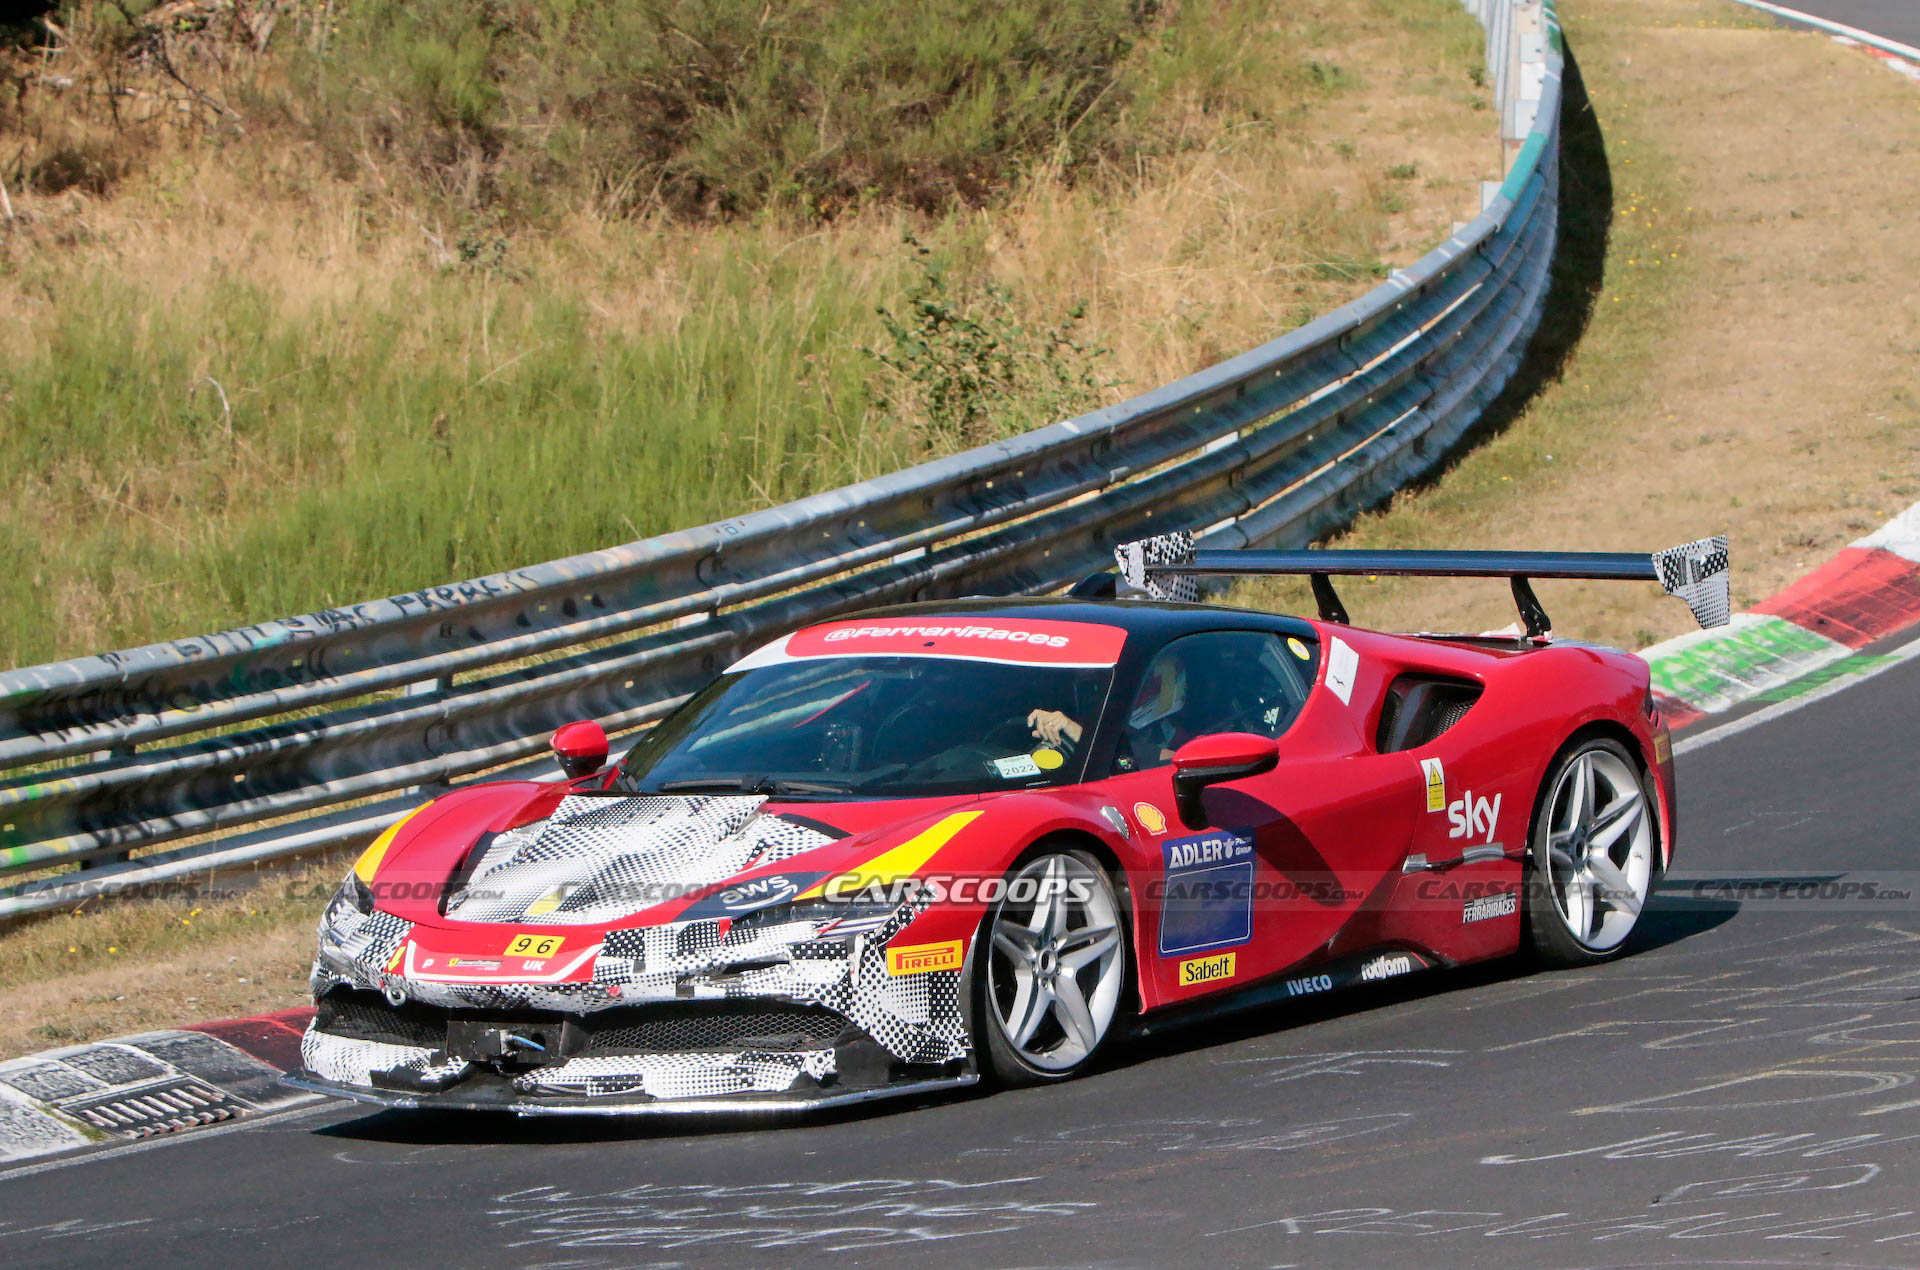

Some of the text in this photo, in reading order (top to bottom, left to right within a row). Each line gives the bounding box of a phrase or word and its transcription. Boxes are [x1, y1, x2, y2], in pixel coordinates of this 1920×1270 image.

[823, 625, 1070, 648] @FerrariRaces
[1003, 763, 1036, 776] 2022
[1447, 789, 1502, 844] sky
[1169, 839, 1223, 869] ADLER
[719, 875, 790, 904] aws
[1462, 898, 1517, 924] FERRARIRACES
[514, 937, 555, 954] 96
[522, 959, 546, 971] UK
[895, 946, 955, 970] PIRELLI
[1185, 957, 1230, 982] Sabelt
[1286, 974, 1333, 996] IVECO
[1203, 1208, 1920, 1243] RENAUL
